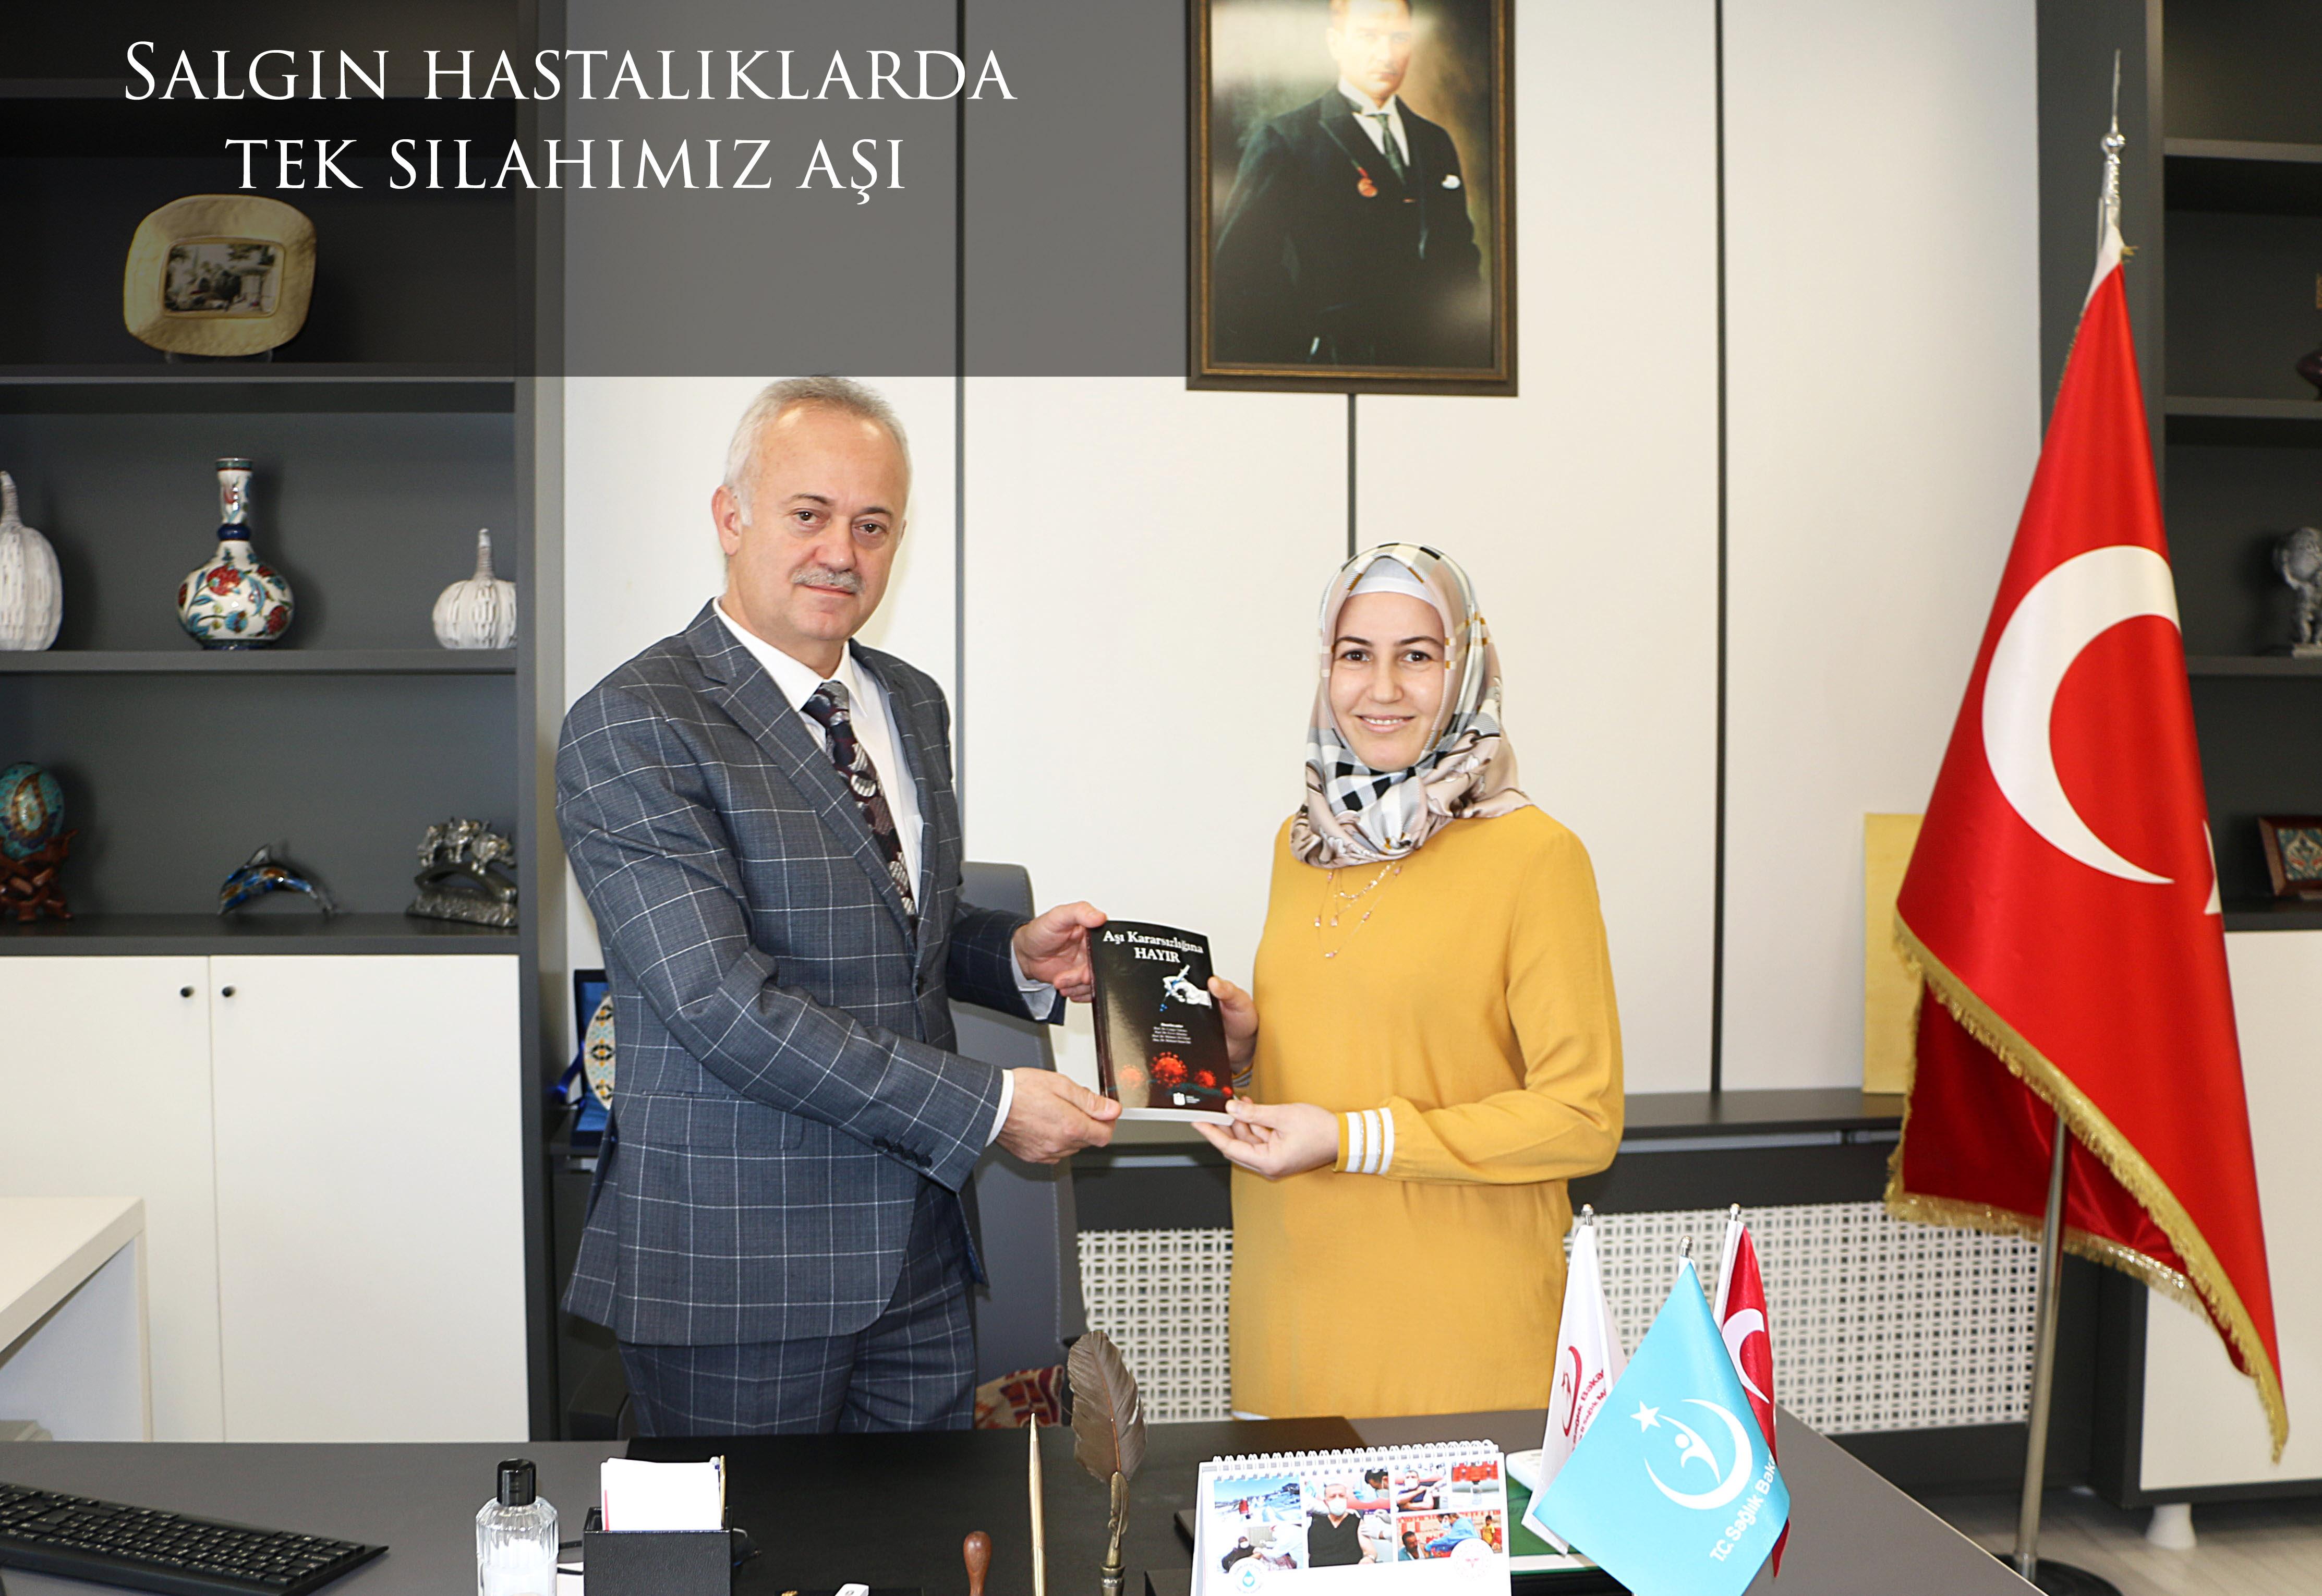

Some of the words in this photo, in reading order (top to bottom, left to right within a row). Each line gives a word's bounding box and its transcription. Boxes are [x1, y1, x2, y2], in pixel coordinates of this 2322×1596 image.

[1103, 930, 1125, 945] Aşı
[1127, 931, 1204, 953] Kararsızlığına
[1133, 947, 1181, 963] HAYIR
[1581, 1369, 1604, 1401] Baka
[1709, 1539, 1735, 1562] T.C.
[1725, 1494, 1764, 1541] Sağlık
[1755, 1450, 1776, 1495] Baka
